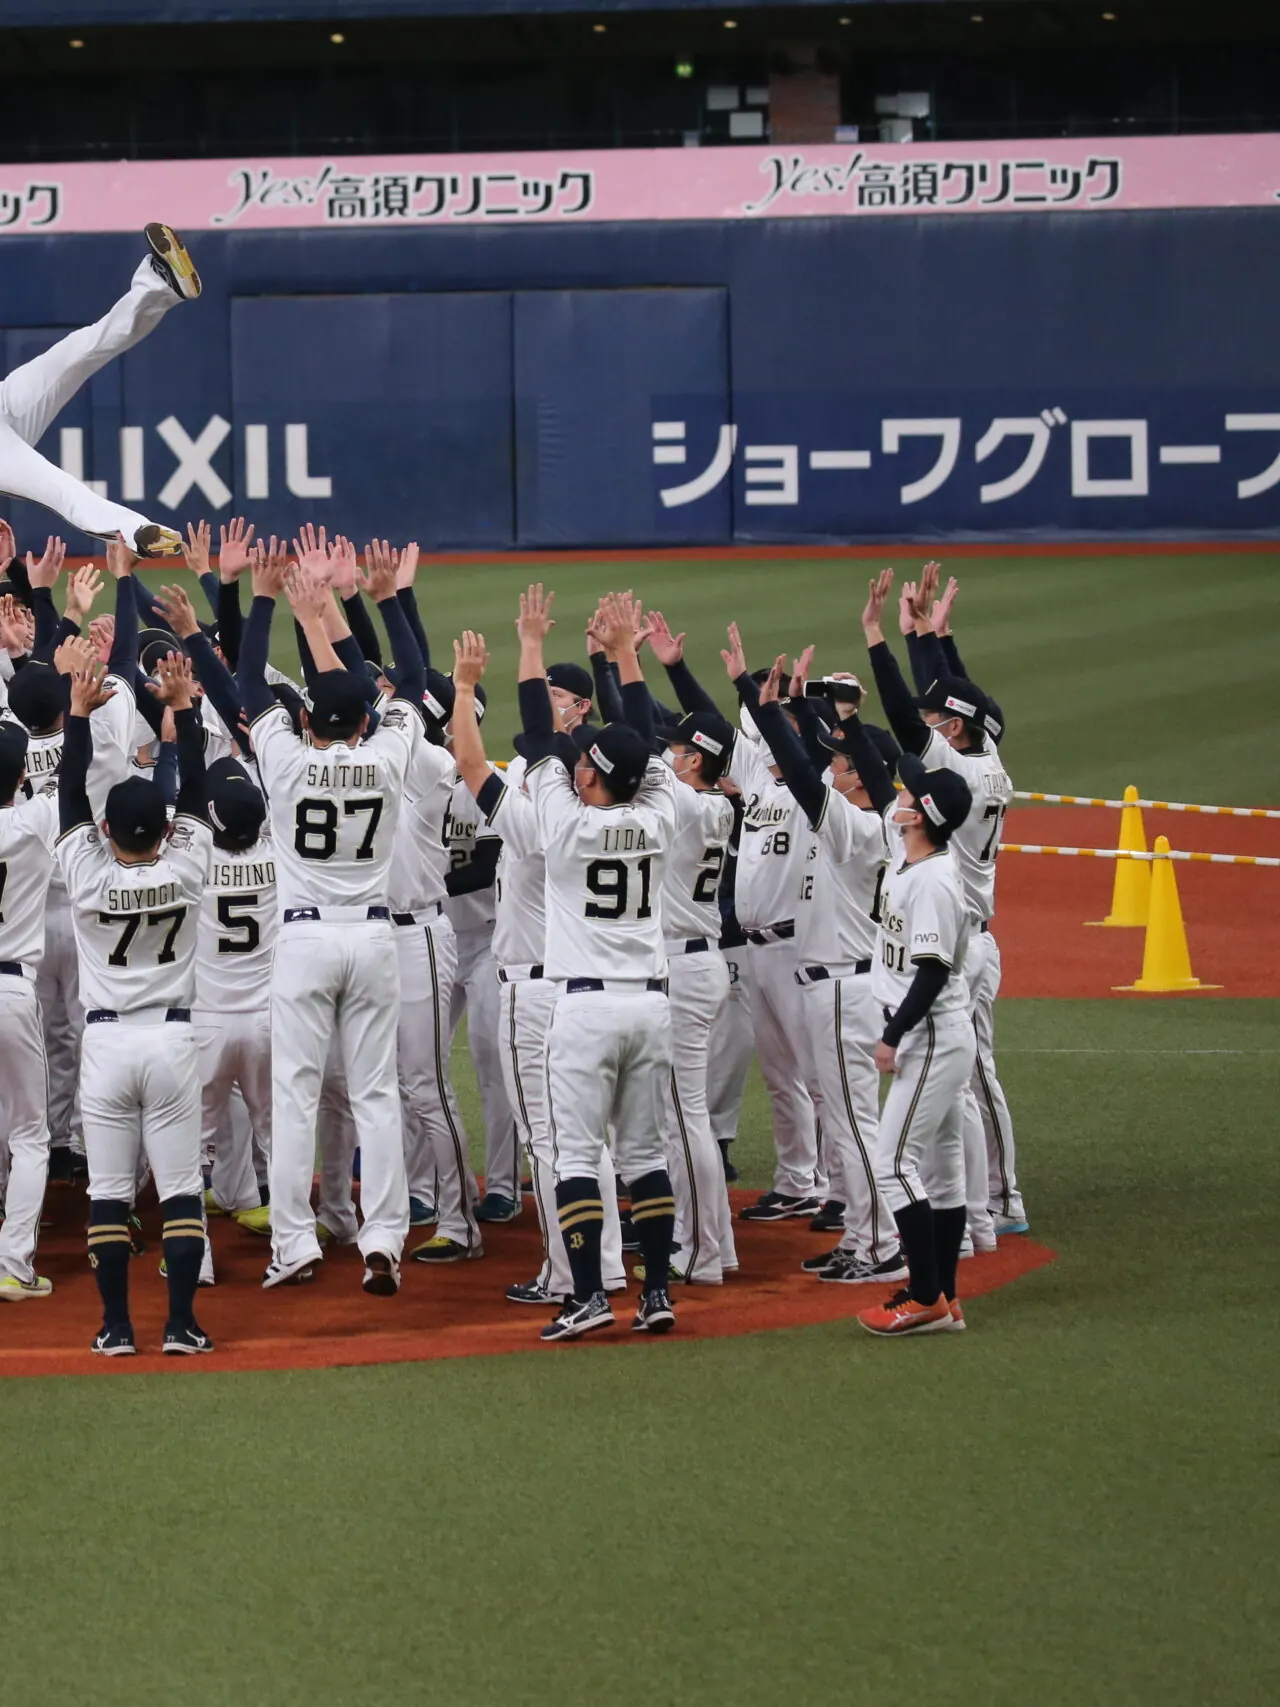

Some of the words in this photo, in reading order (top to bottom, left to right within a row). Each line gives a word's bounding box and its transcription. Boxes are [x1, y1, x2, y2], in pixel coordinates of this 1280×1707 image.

[328, 171, 592, 219] 高須クリニック
[857, 157, 1121, 207] 高須クリニック
[59, 414, 333, 510] LIXIL
[307, 765, 376, 788] SAITOH
[294, 797, 384, 861] 87
[604, 829, 647, 851] IIDA
[108, 882, 177, 911] SOYOGI
[206, 861, 277, 887] ISHINO
[584, 857, 652, 920] 91
[98, 906, 188, 968] 77
[217, 894, 260, 953] 5
